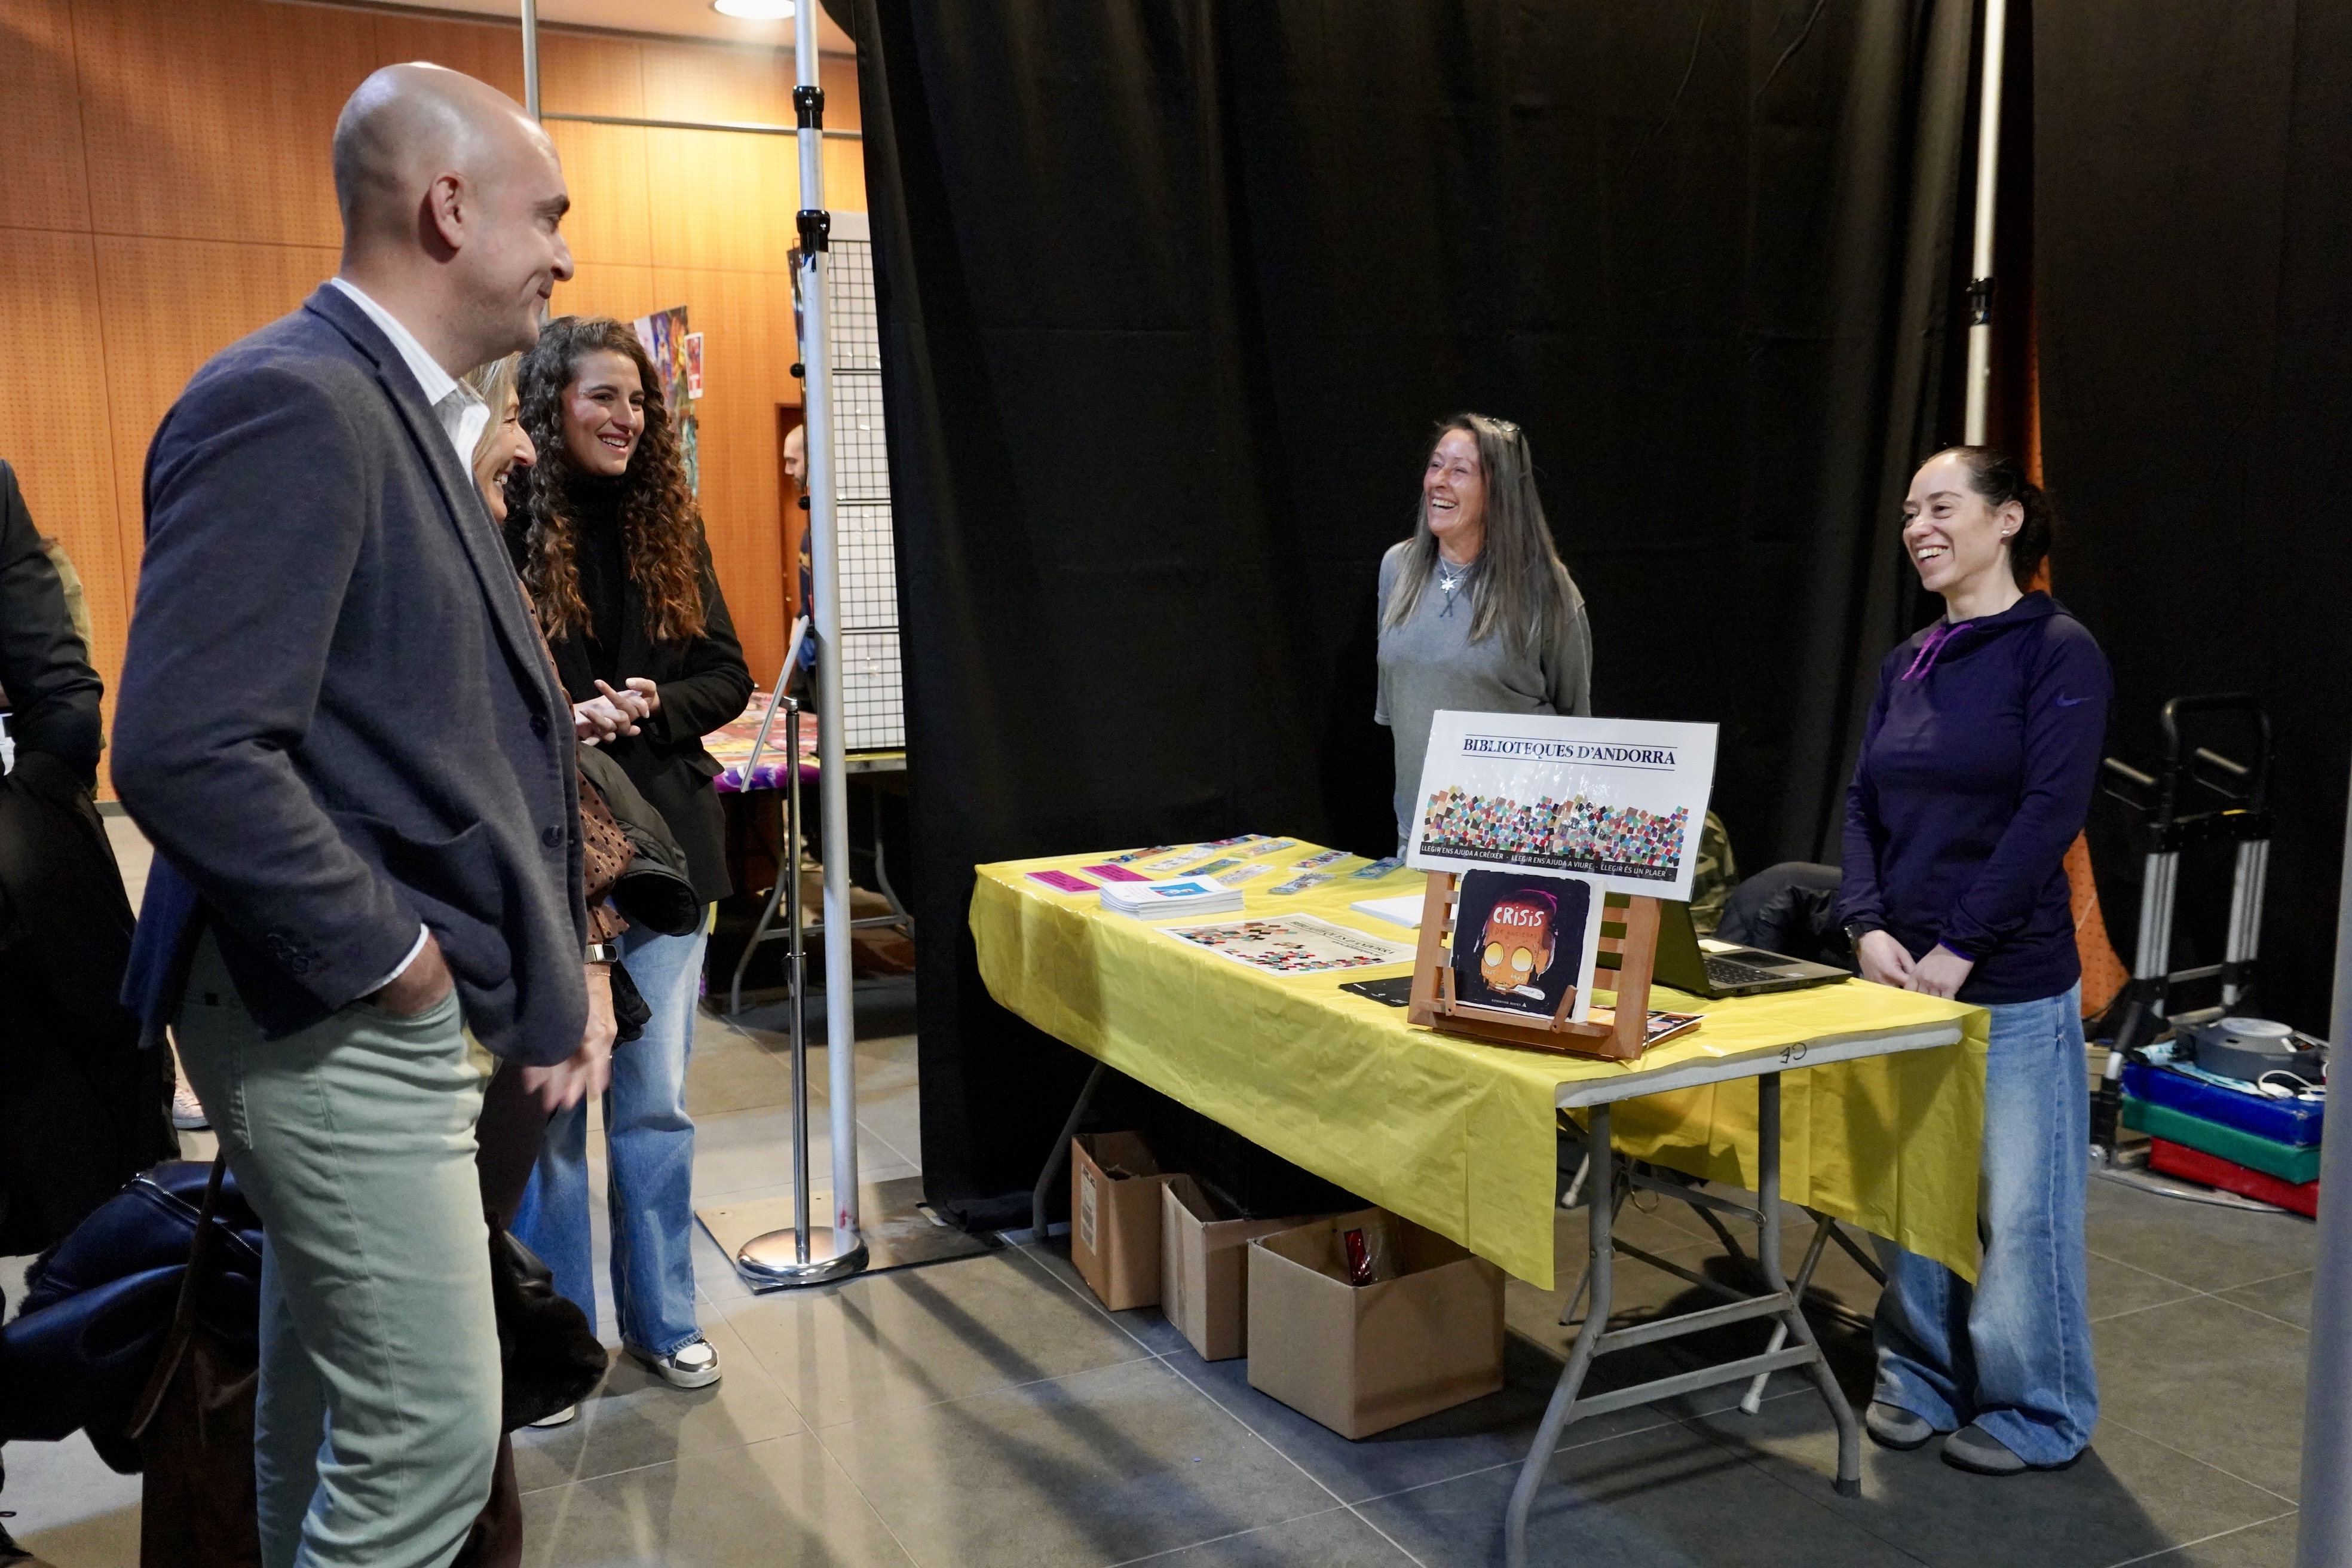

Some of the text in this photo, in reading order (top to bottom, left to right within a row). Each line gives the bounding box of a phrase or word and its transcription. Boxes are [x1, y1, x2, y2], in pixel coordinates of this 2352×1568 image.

[1463, 739, 1676, 765] BIBLIOTEQUES D'ANDORRA
[1421, 845, 1441, 853] LLEGIR
[1479, 850, 1503, 859] CRÉIXER
[1511, 855, 1532, 863] LLEGIR
[1573, 861, 1593, 869] VIURE
[1601, 864, 1623, 872] LLEGIR
